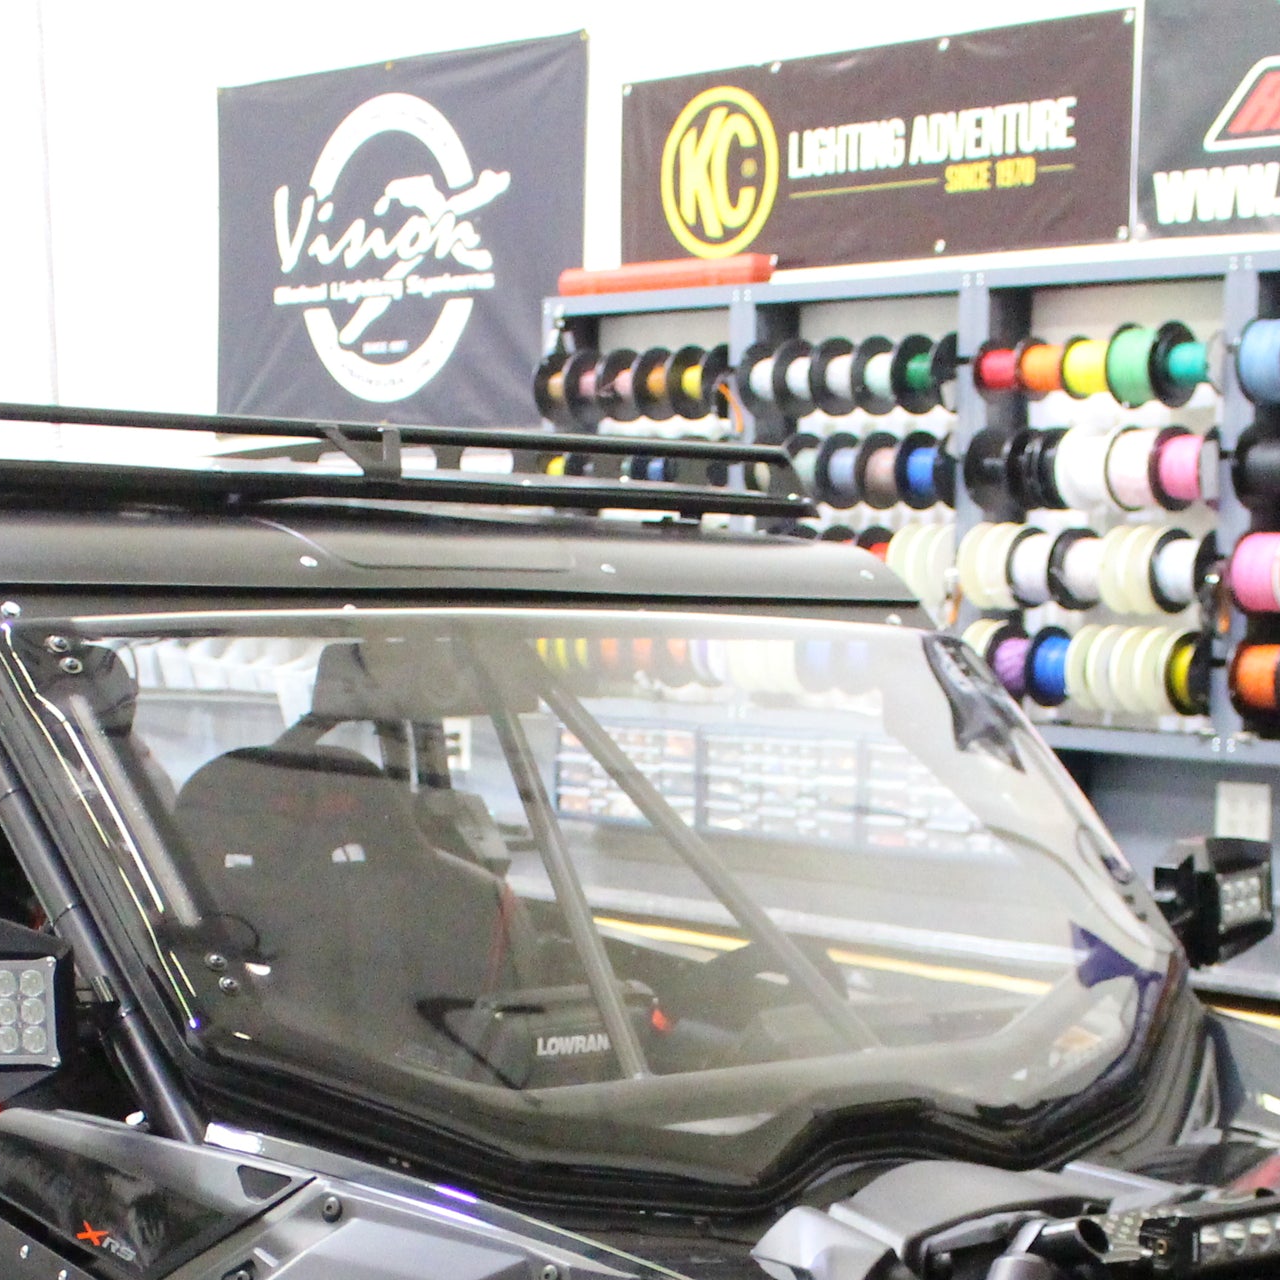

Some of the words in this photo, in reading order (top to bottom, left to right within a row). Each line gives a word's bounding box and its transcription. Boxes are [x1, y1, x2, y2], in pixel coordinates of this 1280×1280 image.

[678, 106, 759, 238] KC
[787, 118, 907, 180] LIGHTING
[908, 96, 1078, 166] ADVENTURE
[944, 160, 992, 194] SINCE
[273, 184, 482, 274] Vision
